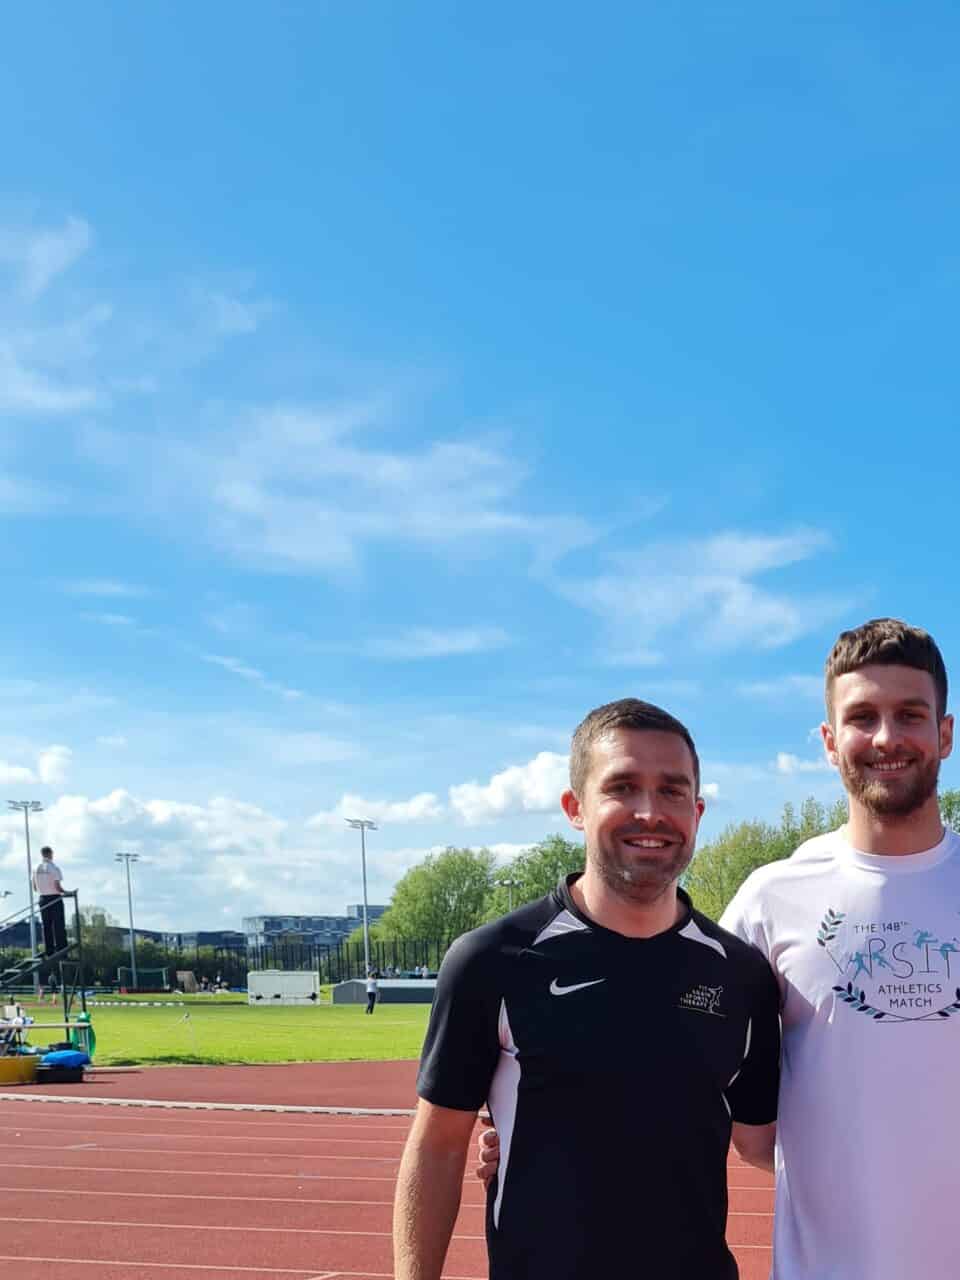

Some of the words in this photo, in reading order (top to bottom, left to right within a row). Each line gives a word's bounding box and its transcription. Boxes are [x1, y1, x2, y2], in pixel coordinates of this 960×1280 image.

[854, 923, 877, 934] THE
[878, 982, 942, 995] ATHLETICS
[889, 998, 932, 1009] MATCH
